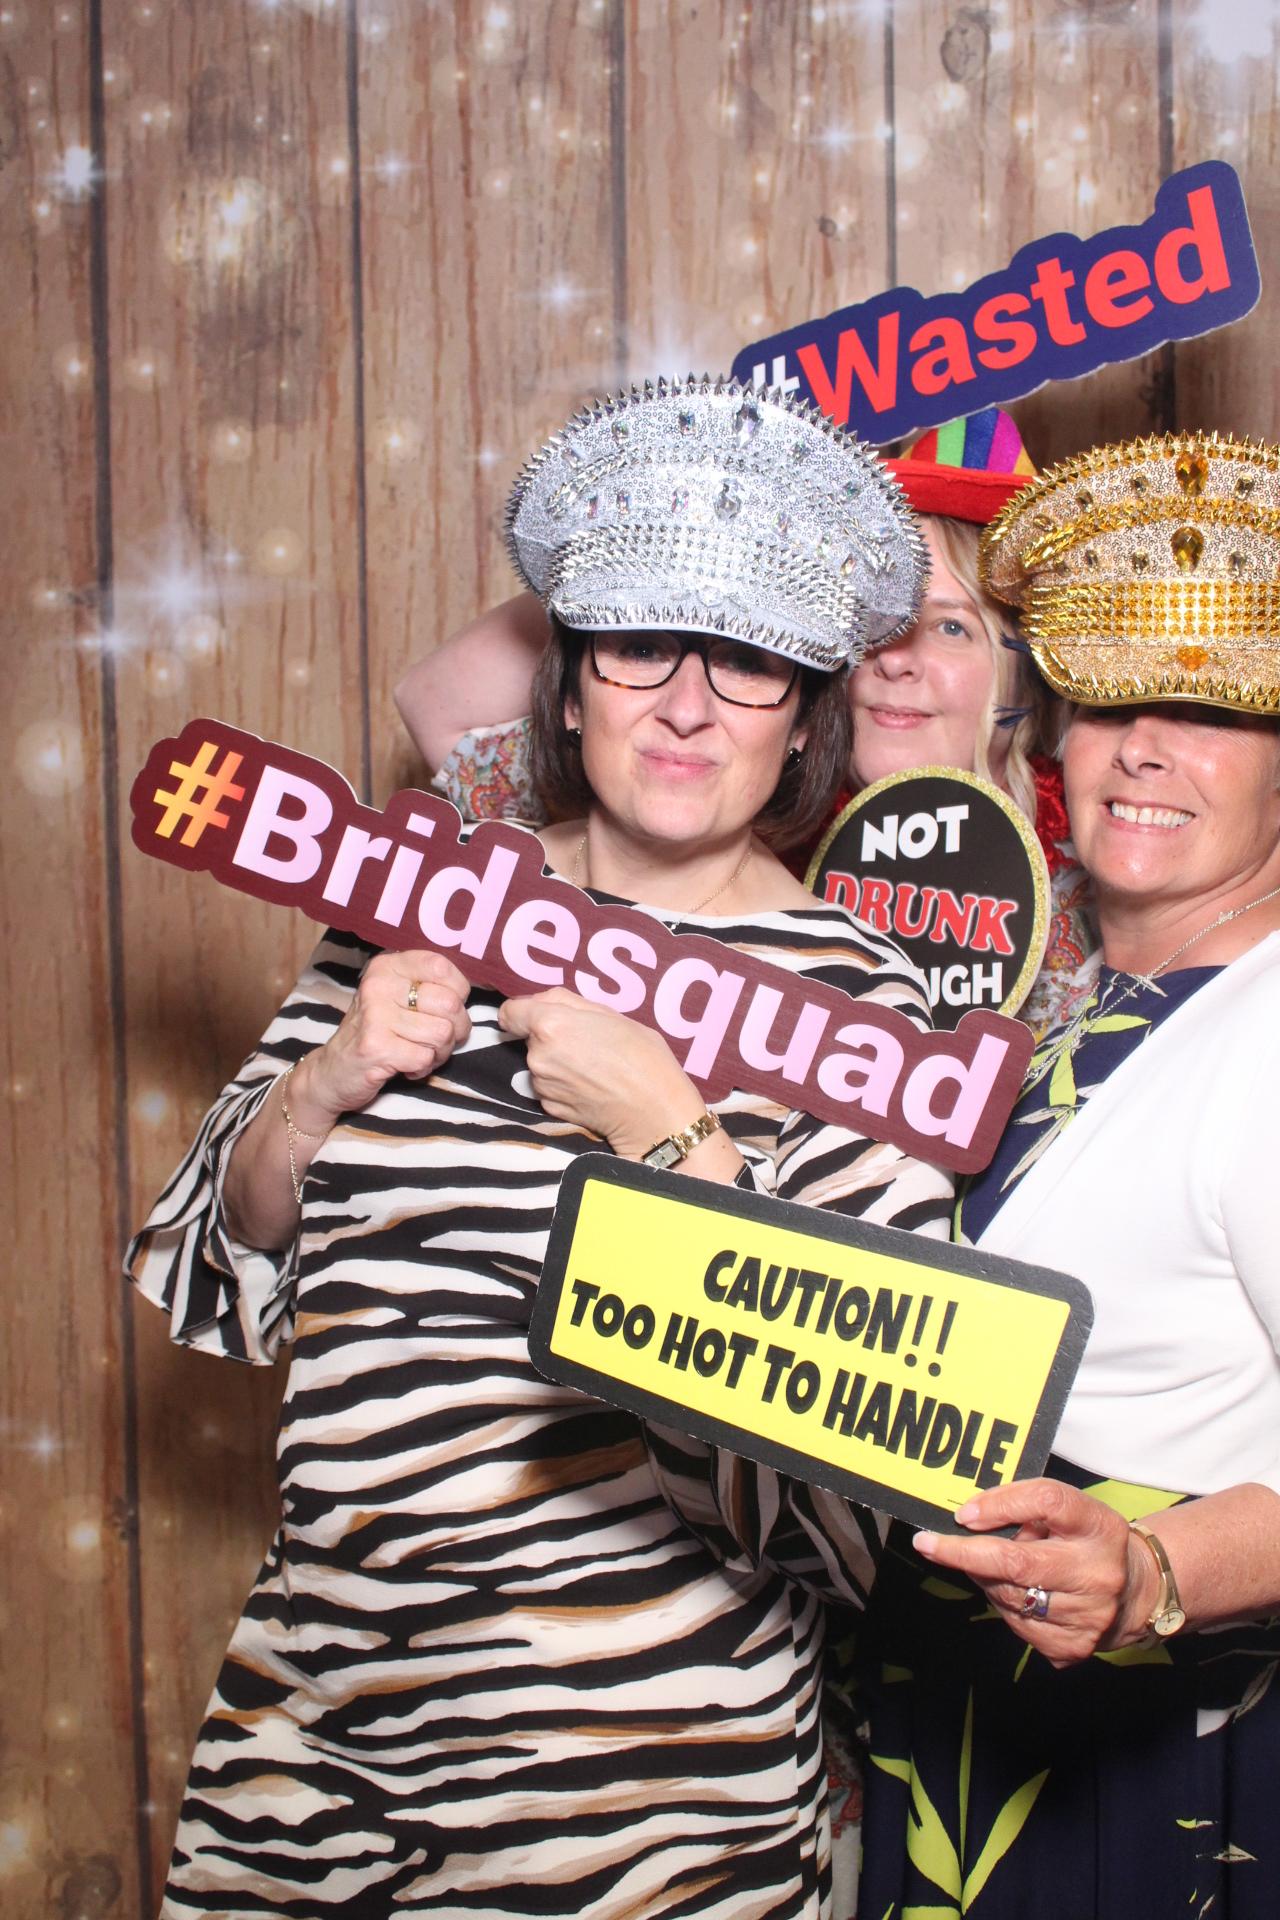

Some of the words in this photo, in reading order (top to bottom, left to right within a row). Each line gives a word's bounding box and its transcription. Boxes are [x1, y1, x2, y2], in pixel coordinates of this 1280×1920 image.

[860, 804, 969, 863] NOT
[152, 740, 1010, 1150] #Bridesquad
[823, 870, 1020, 956] DRUNK
[703, 1249, 959, 1378] CAUTION!!
[571, 1278, 656, 1350] TOO
[658, 1312, 759, 1389] HOT
[760, 1348, 822, 1415] TO
[822, 1368, 1018, 1490] HANDLE
